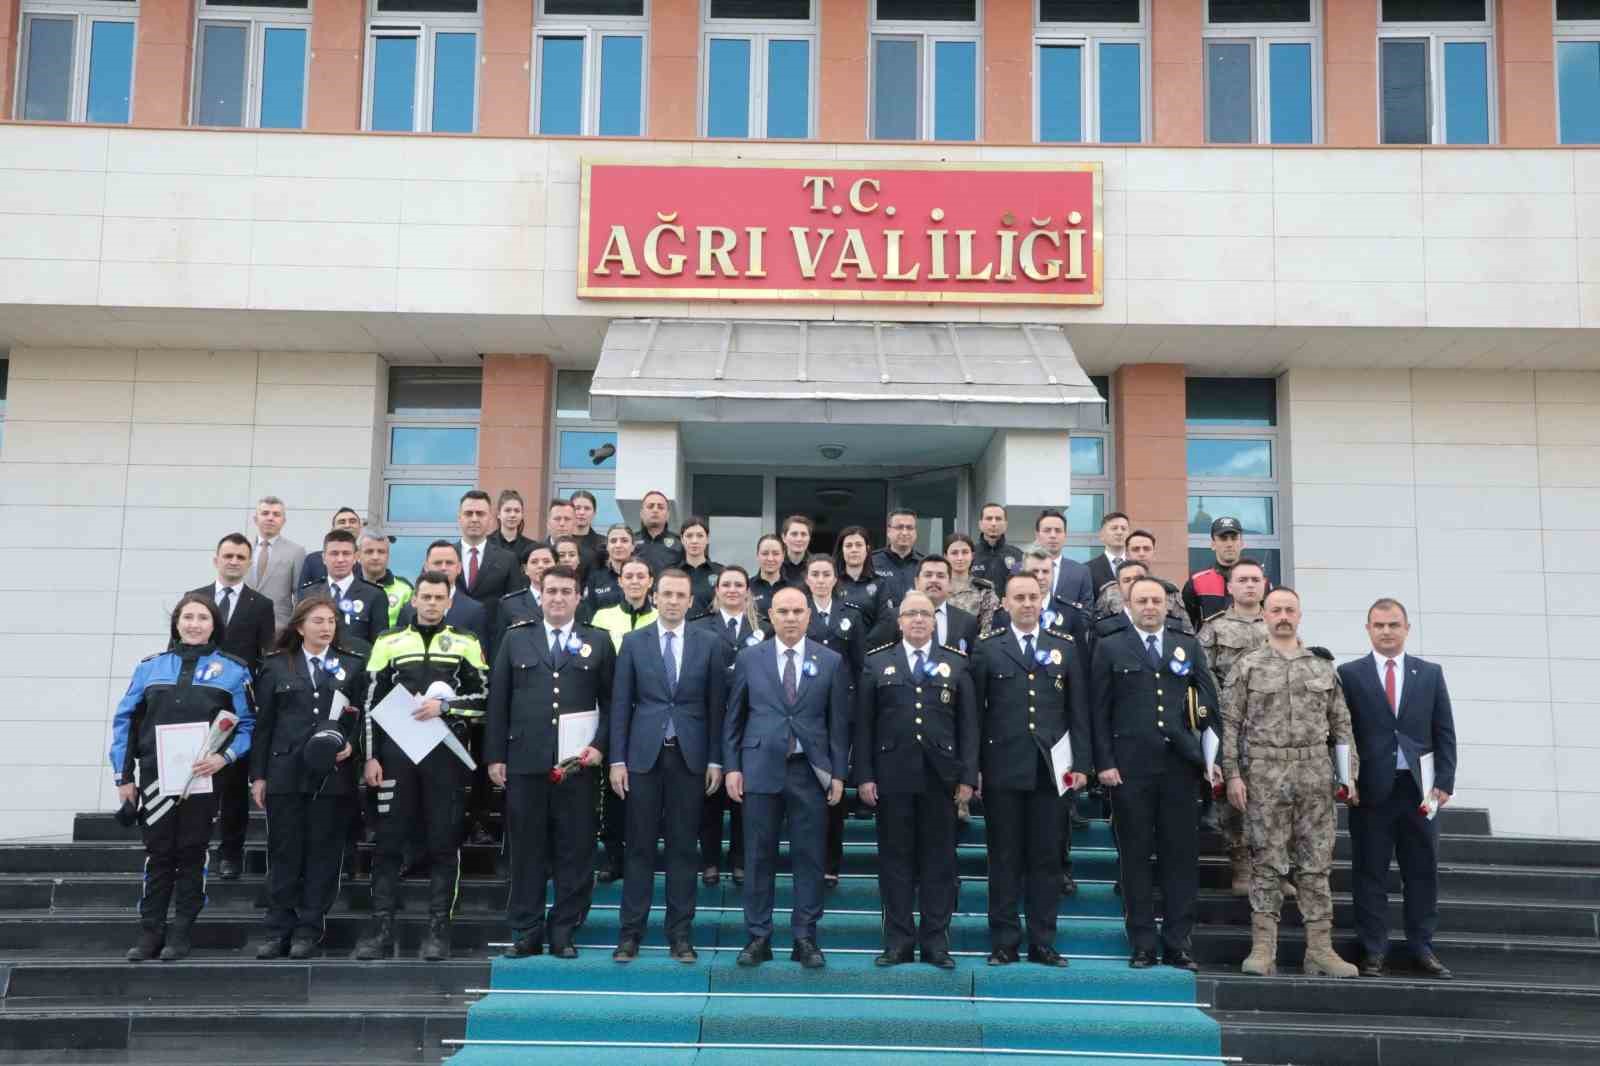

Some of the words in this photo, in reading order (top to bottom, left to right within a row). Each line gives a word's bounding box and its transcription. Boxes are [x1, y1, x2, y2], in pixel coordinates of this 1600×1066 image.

[803, 175, 896, 216] T.C.
[593, 211, 767, 277] AĞRI
[789, 208, 1088, 281] VALİLİĞİ
